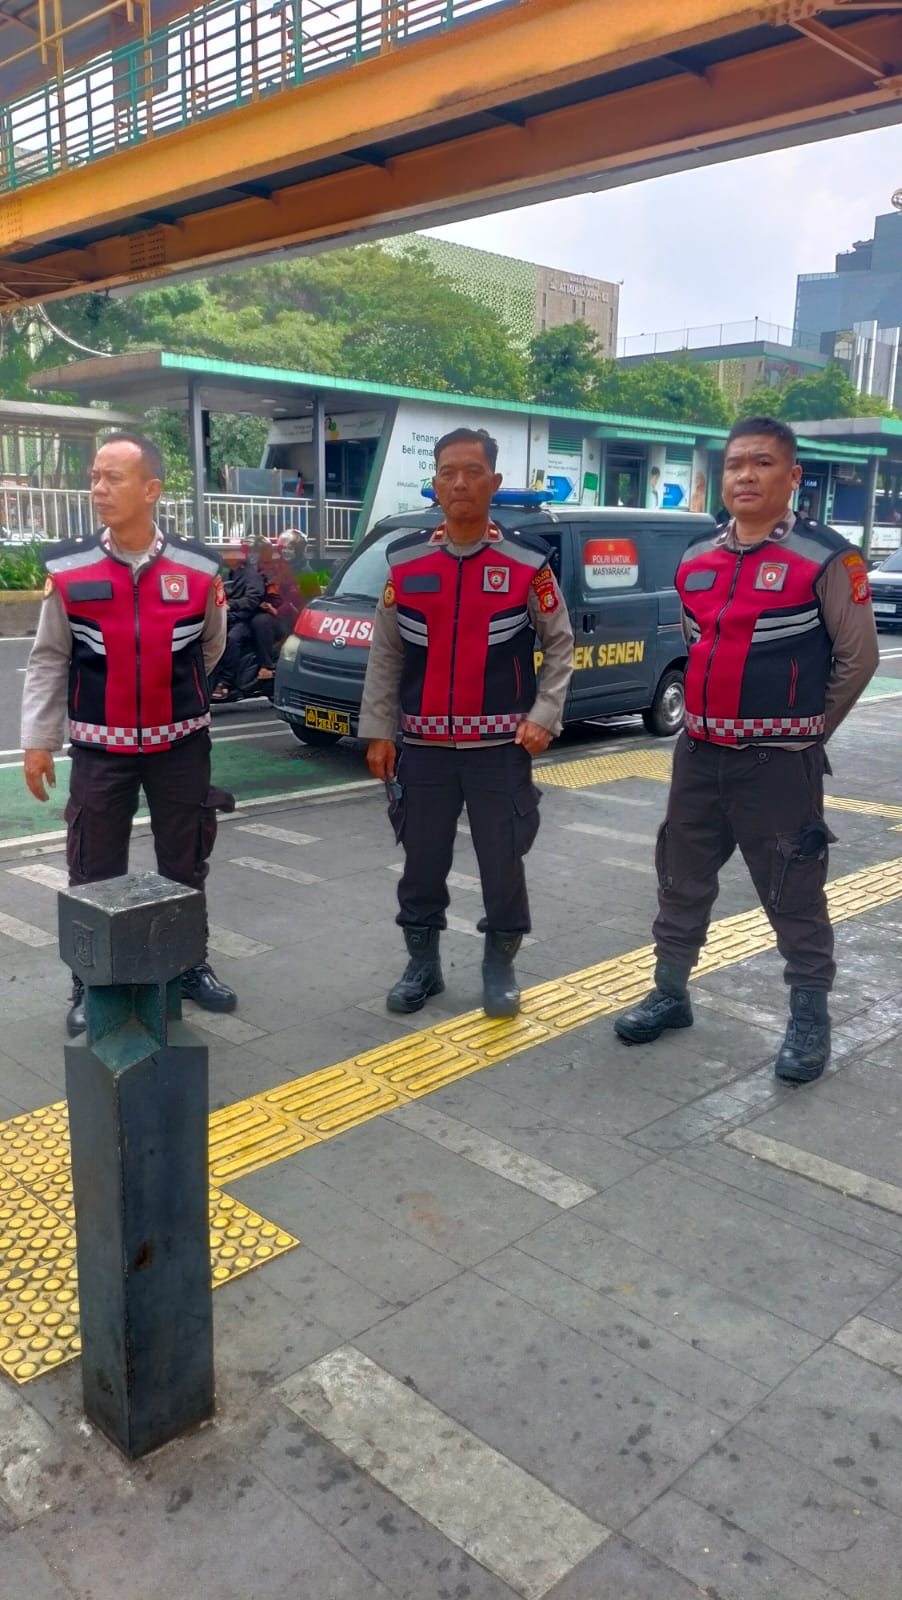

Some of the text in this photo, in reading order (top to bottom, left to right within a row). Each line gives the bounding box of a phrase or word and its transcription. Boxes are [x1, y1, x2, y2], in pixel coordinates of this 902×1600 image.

[402, 445, 435, 457] Beli ema
[592, 554, 631, 564] POLRI UNTUK
[592, 566, 632, 576] MASYARAKAT
[597, 640, 645, 667] SENEN
